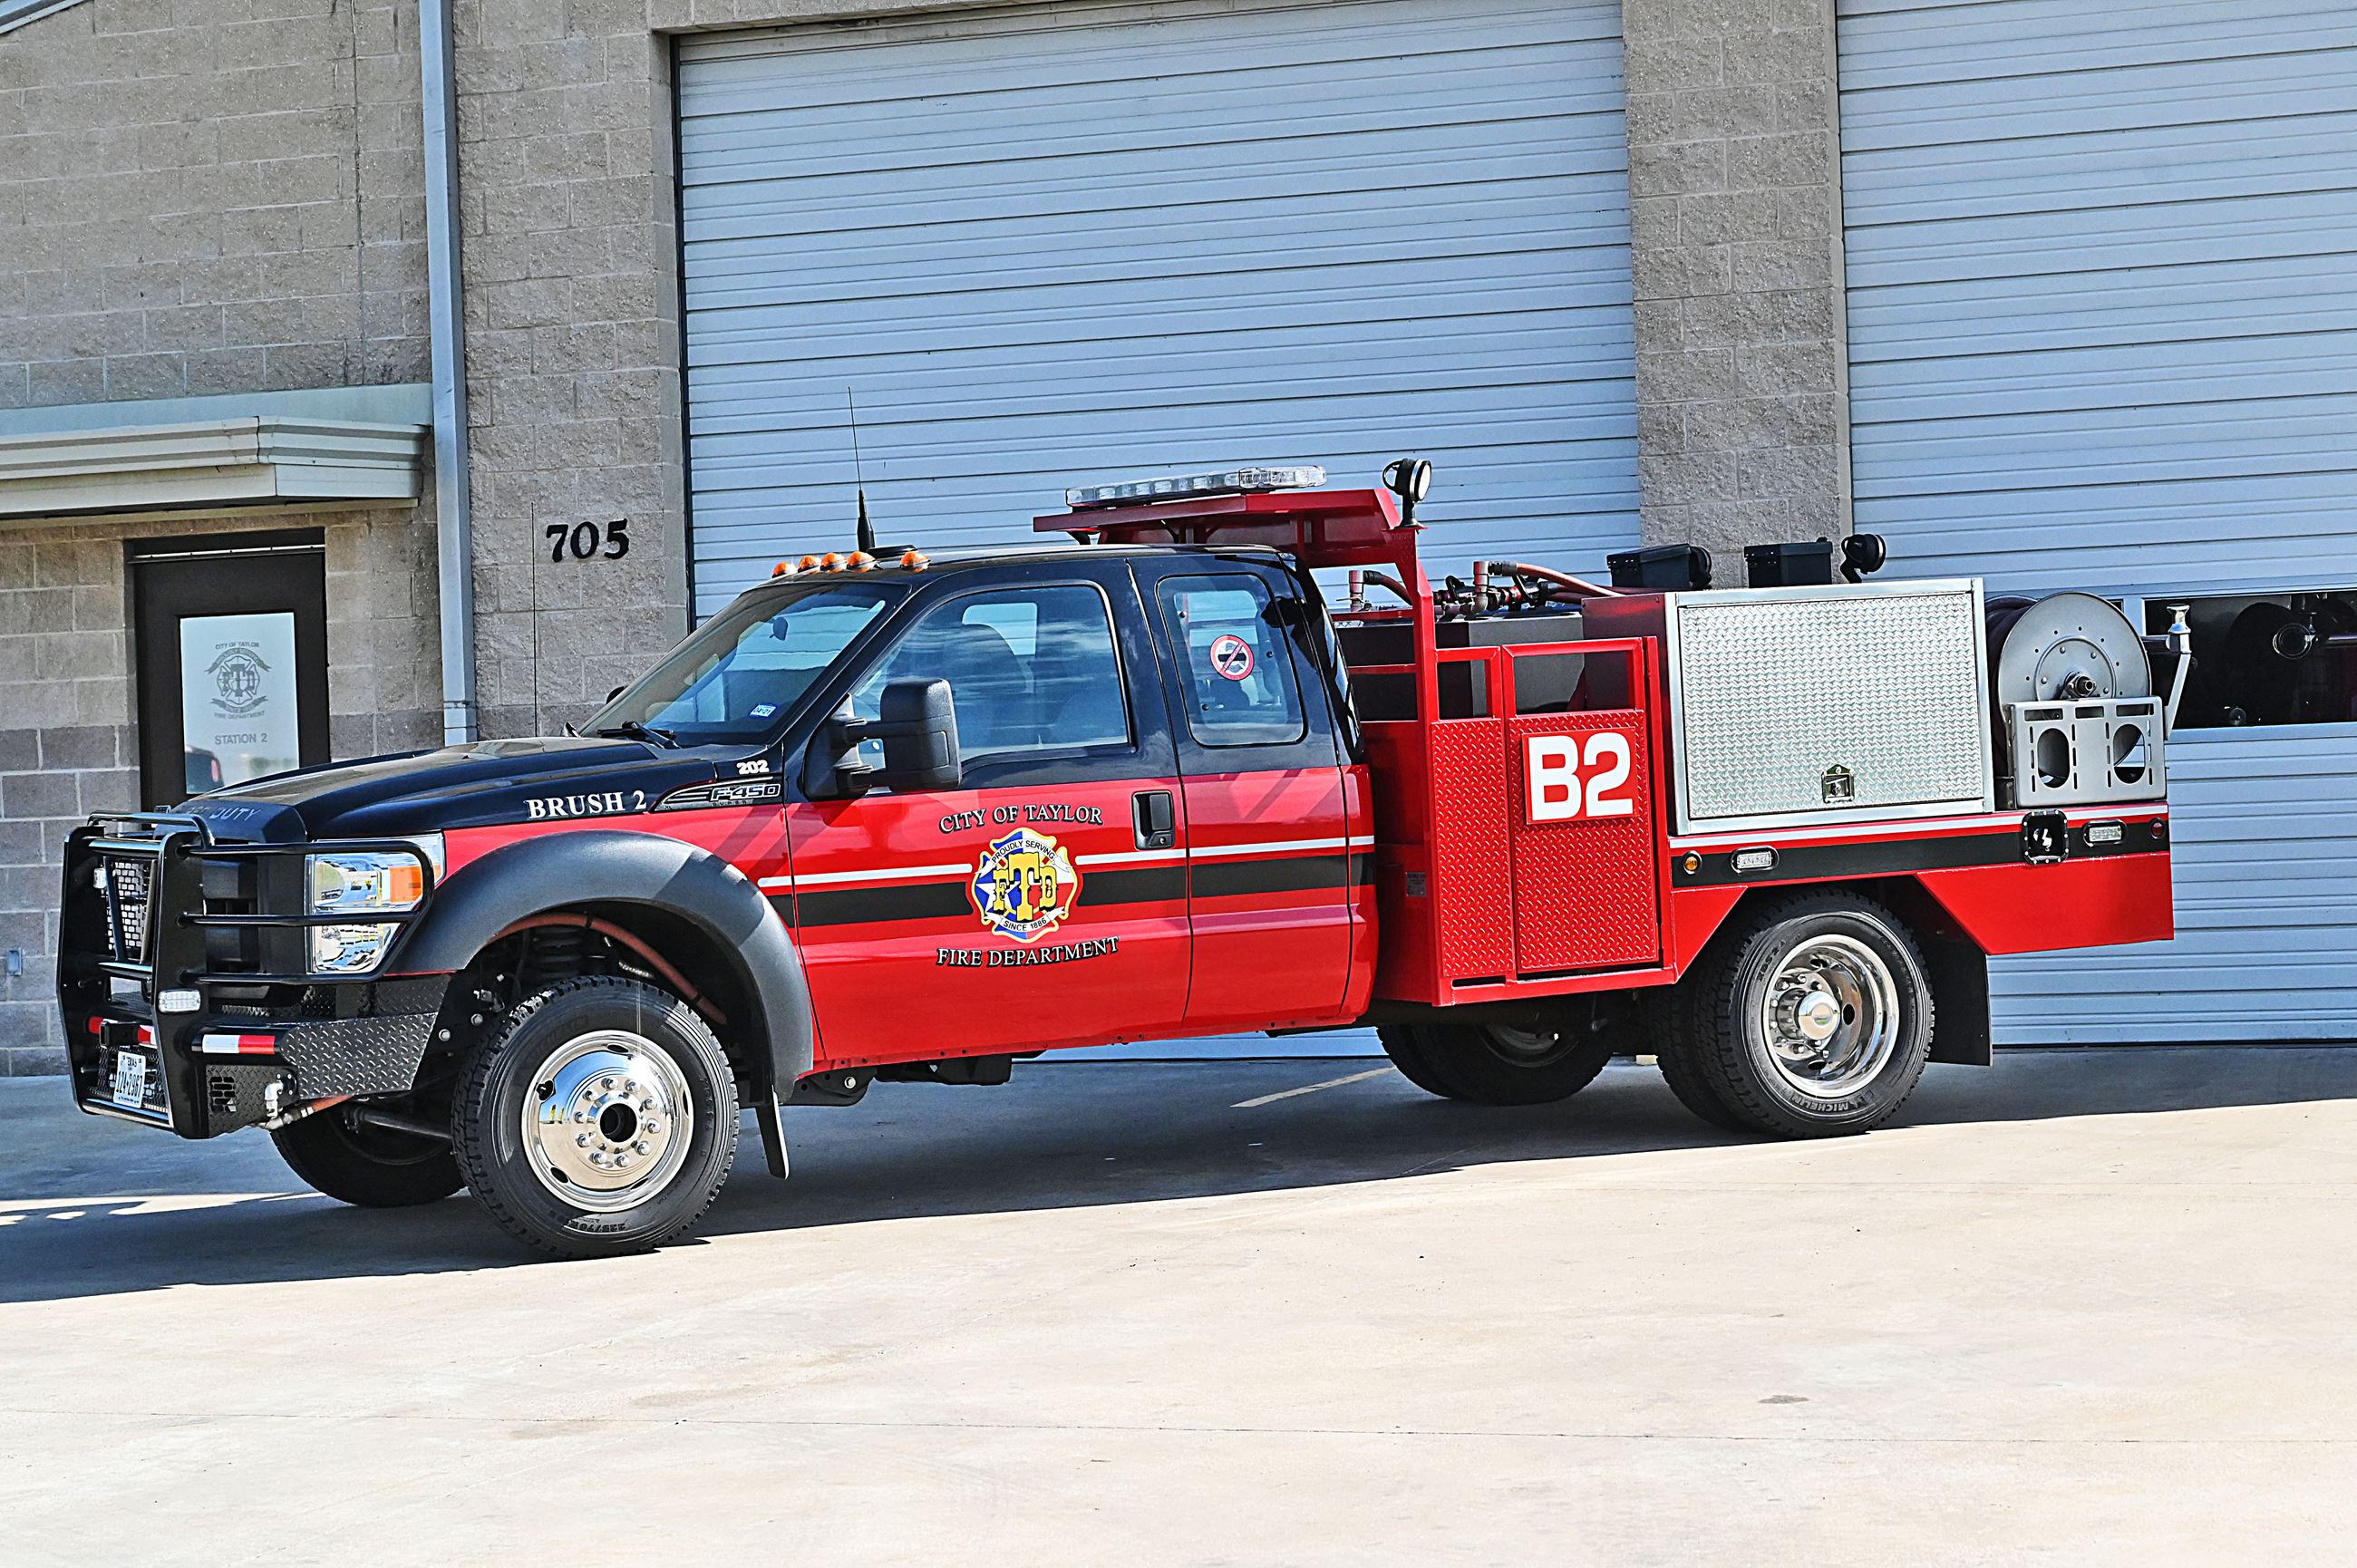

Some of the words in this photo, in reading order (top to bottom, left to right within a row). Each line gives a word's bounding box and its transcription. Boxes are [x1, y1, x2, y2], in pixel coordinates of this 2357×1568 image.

[546, 518, 629, 563] 705
[215, 733, 257, 745] STATION
[261, 733, 267, 742] 2
[737, 760, 770, 775] 202
[1528, 732, 1633, 821] B2
[523, 791, 626, 819] BRUSH
[632, 790, 646, 810] 2
[710, 784, 781, 801] F-450
[939, 808, 986, 834] CITY
[992, 805, 1019, 824] OF
[1023, 804, 1103, 825] TAYLOR
[991, 840, 1023, 864] PROUDLY
[1025, 840, 1056, 860] SERVING
[993, 852, 1058, 923] FTD
[1003, 920, 1027, 932] SINCE
[1030, 918, 1047, 929] 1886
[936, 948, 983, 967] FIRE
[986, 935, 1119, 968] DEPARTMENT
[1790, 1092, 1849, 1112] MICHELIN
